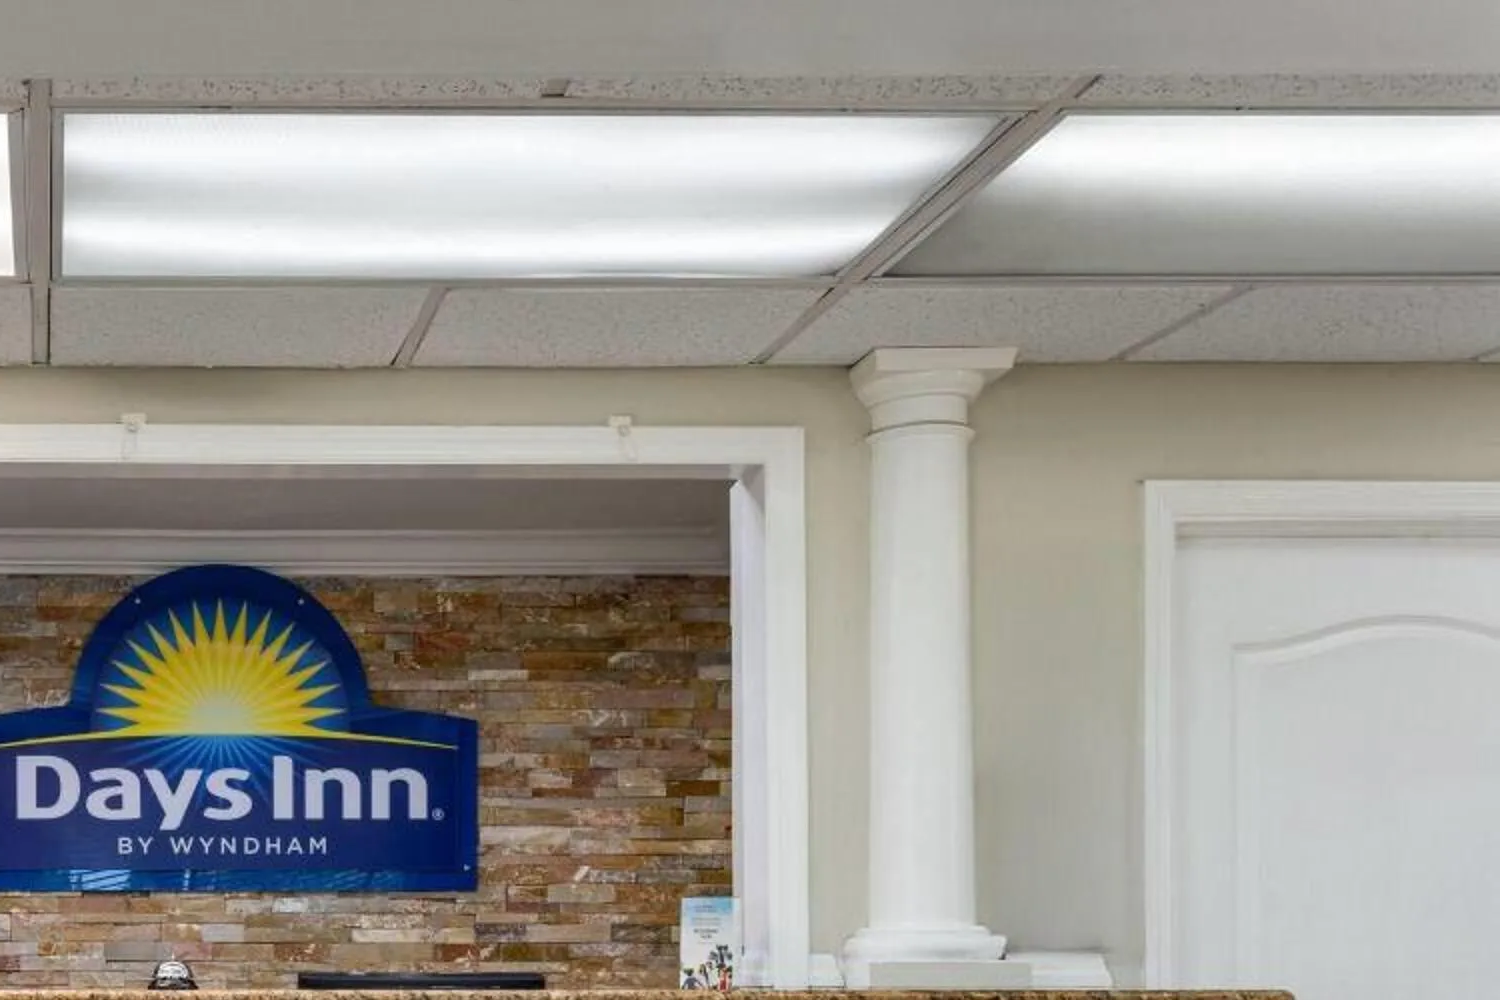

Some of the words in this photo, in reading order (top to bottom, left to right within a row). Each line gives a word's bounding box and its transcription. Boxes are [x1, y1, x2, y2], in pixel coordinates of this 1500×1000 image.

[15, 755, 253, 831] Days
[117, 836, 153, 855] BY
[169, 836, 328, 855] WYNDHAM
